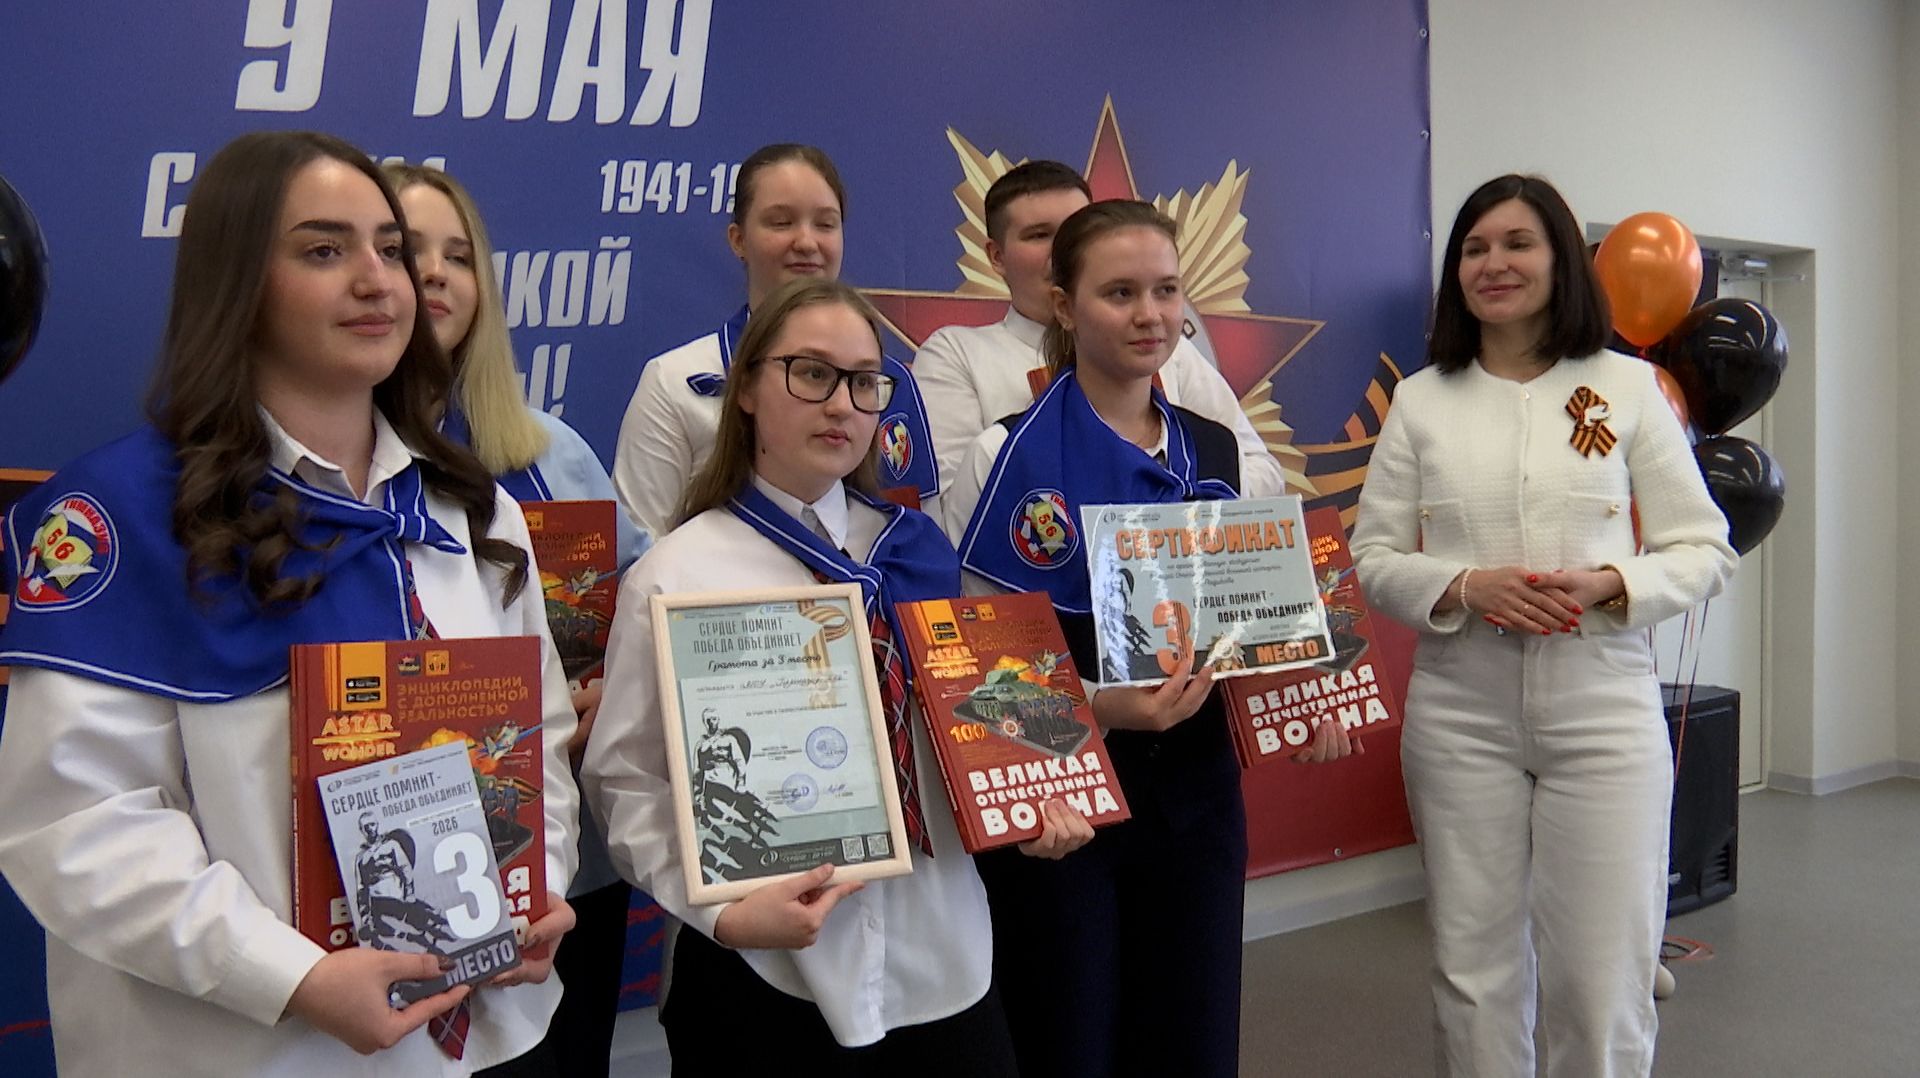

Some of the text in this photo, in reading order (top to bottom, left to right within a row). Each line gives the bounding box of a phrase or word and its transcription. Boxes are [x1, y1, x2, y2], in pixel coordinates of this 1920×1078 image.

[235, 0, 712, 127] 9 МАЯ
[54, 541, 75, 560] 6
[1115, 519, 1295, 561] СЕРТИФИКАТ
[699, 619, 737, 637] СЕРДЦЕ
[742, 616, 783, 634] ПОМНИТ
[1152, 600, 1196, 675] 3
[693, 633, 802, 655] ПОБЕДА ОБЪЕДИНЯЕТ
[926, 645, 973, 662] ASTAR
[1255, 639, 1320, 664] МЕСТО
[708, 659, 758, 672] Грамота
[397, 676, 523, 696] ЭНЦИКЛОПЕДИИ
[413, 686, 530, 709] ДОПОЛНЕННОЙ
[1246, 663, 1376, 715] ВЕЛИКАЯ
[397, 703, 509, 723] РЕАЛЬНОСТЬЮ
[1251, 681, 1380, 729] ОТЕЧЕСТВЕННАЯ
[321, 713, 394, 738] ASTAR
[321, 742, 398, 762] WONDER
[967, 751, 1102, 793] ВЕЛИКАЯ
[331, 788, 381, 816] СЕРДЦЕ
[381, 798, 418, 818] ПОБЕДА
[418, 781, 474, 807] ОБЪЕДИНЯЕТ
[975, 772, 1107, 807] ОТЕЧЕСТВЕННАЯ
[980, 787, 1120, 838] ВОНА
[433, 831, 502, 940] 3
[445, 939, 516, 987] МЕСТО
